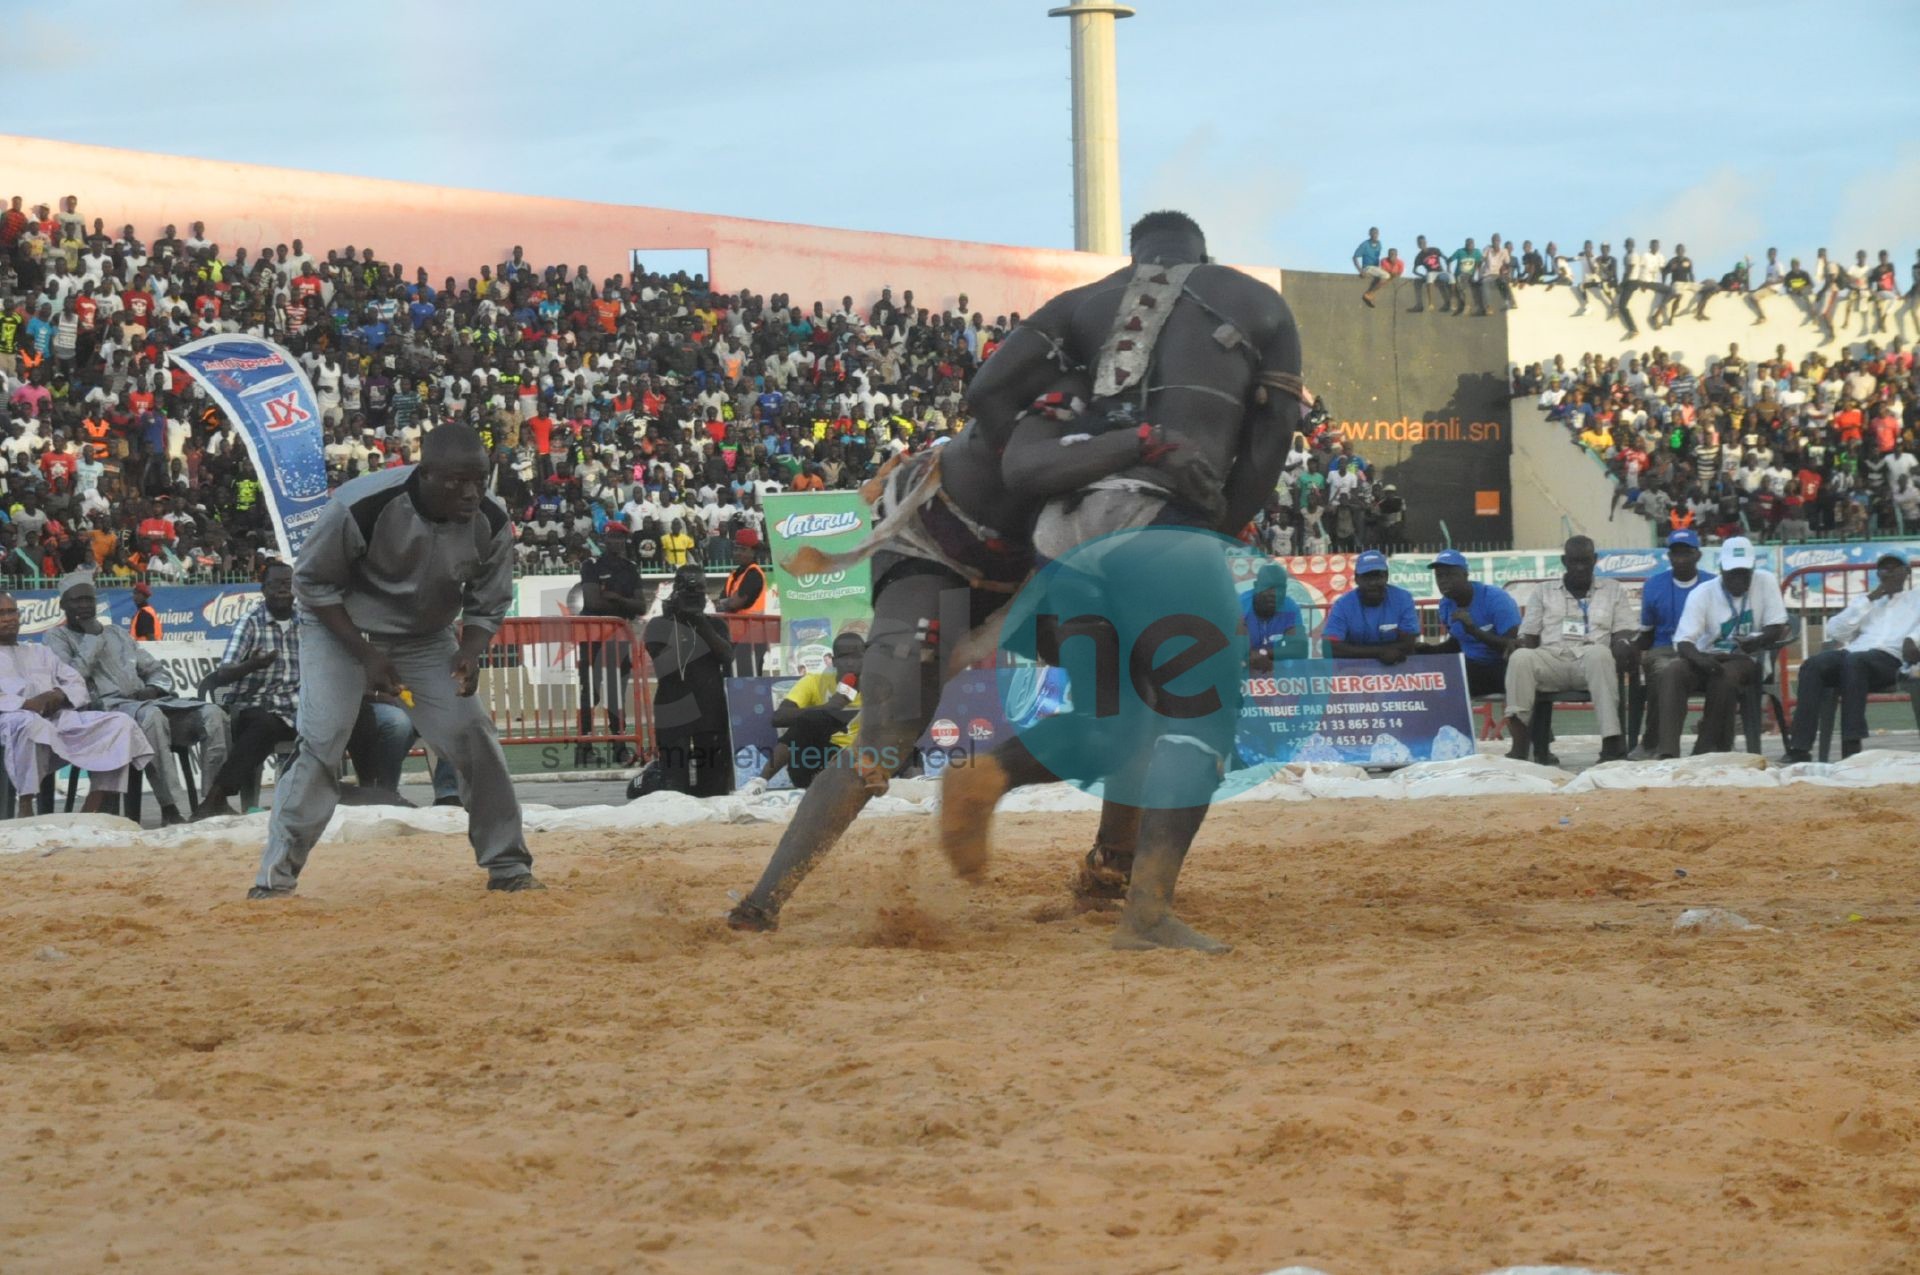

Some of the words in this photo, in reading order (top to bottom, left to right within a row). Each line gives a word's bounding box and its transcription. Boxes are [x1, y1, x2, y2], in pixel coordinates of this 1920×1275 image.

[1310, 672, 1446, 694] ENERGISANTE
[1303, 705, 1324, 715] PAR
[1326, 702, 1379, 714] DISTRIPAD
[1381, 701, 1428, 712] SENEGAL
[1269, 722, 1289, 732] TEL
[1299, 721, 1327, 731] +221
[1331, 720, 1345, 730] 33
[1348, 720, 1369, 729] 865
[1372, 719, 1386, 728] 26
[1389, 718, 1403, 728] 14
[1337, 736, 1357, 745] 453
[1360, 735, 1374, 745] 42
